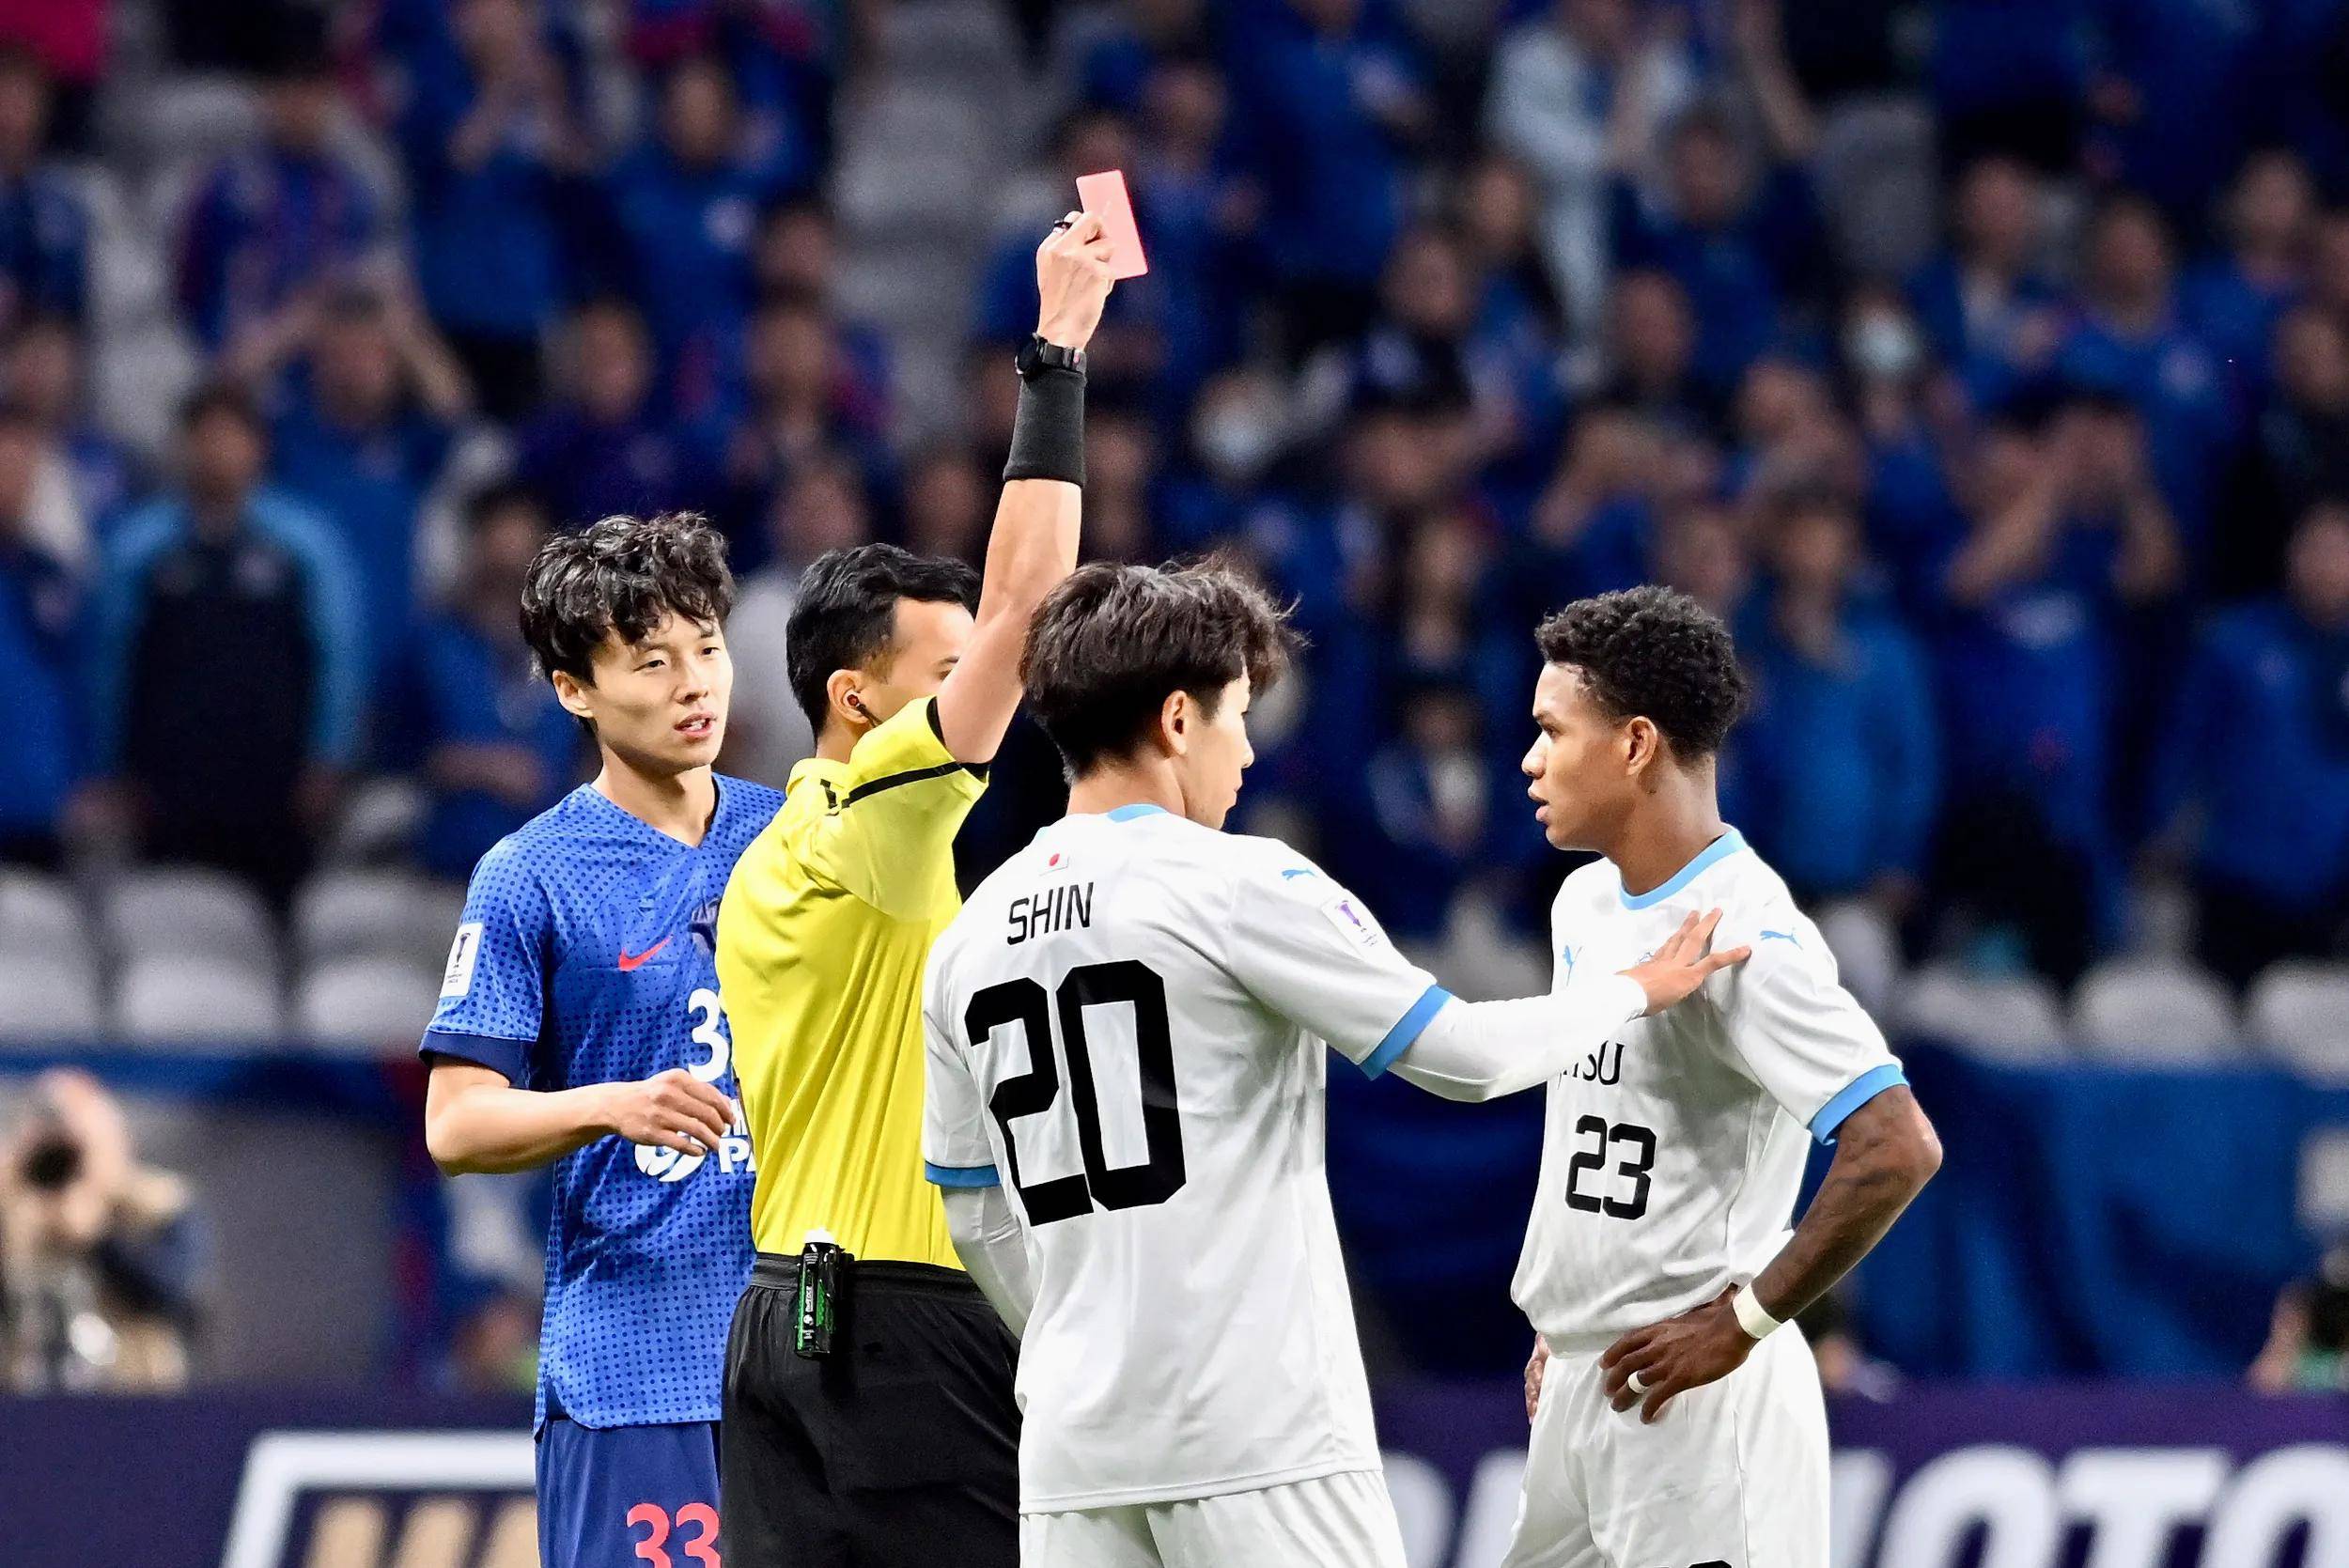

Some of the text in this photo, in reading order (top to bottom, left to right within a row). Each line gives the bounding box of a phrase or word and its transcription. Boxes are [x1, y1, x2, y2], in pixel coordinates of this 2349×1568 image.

[1007, 881, 1094, 945] SHIN
[964, 959, 1187, 1227] 20
[1564, 1114, 1657, 1220] 23
[626, 1502, 722, 1568] 33
